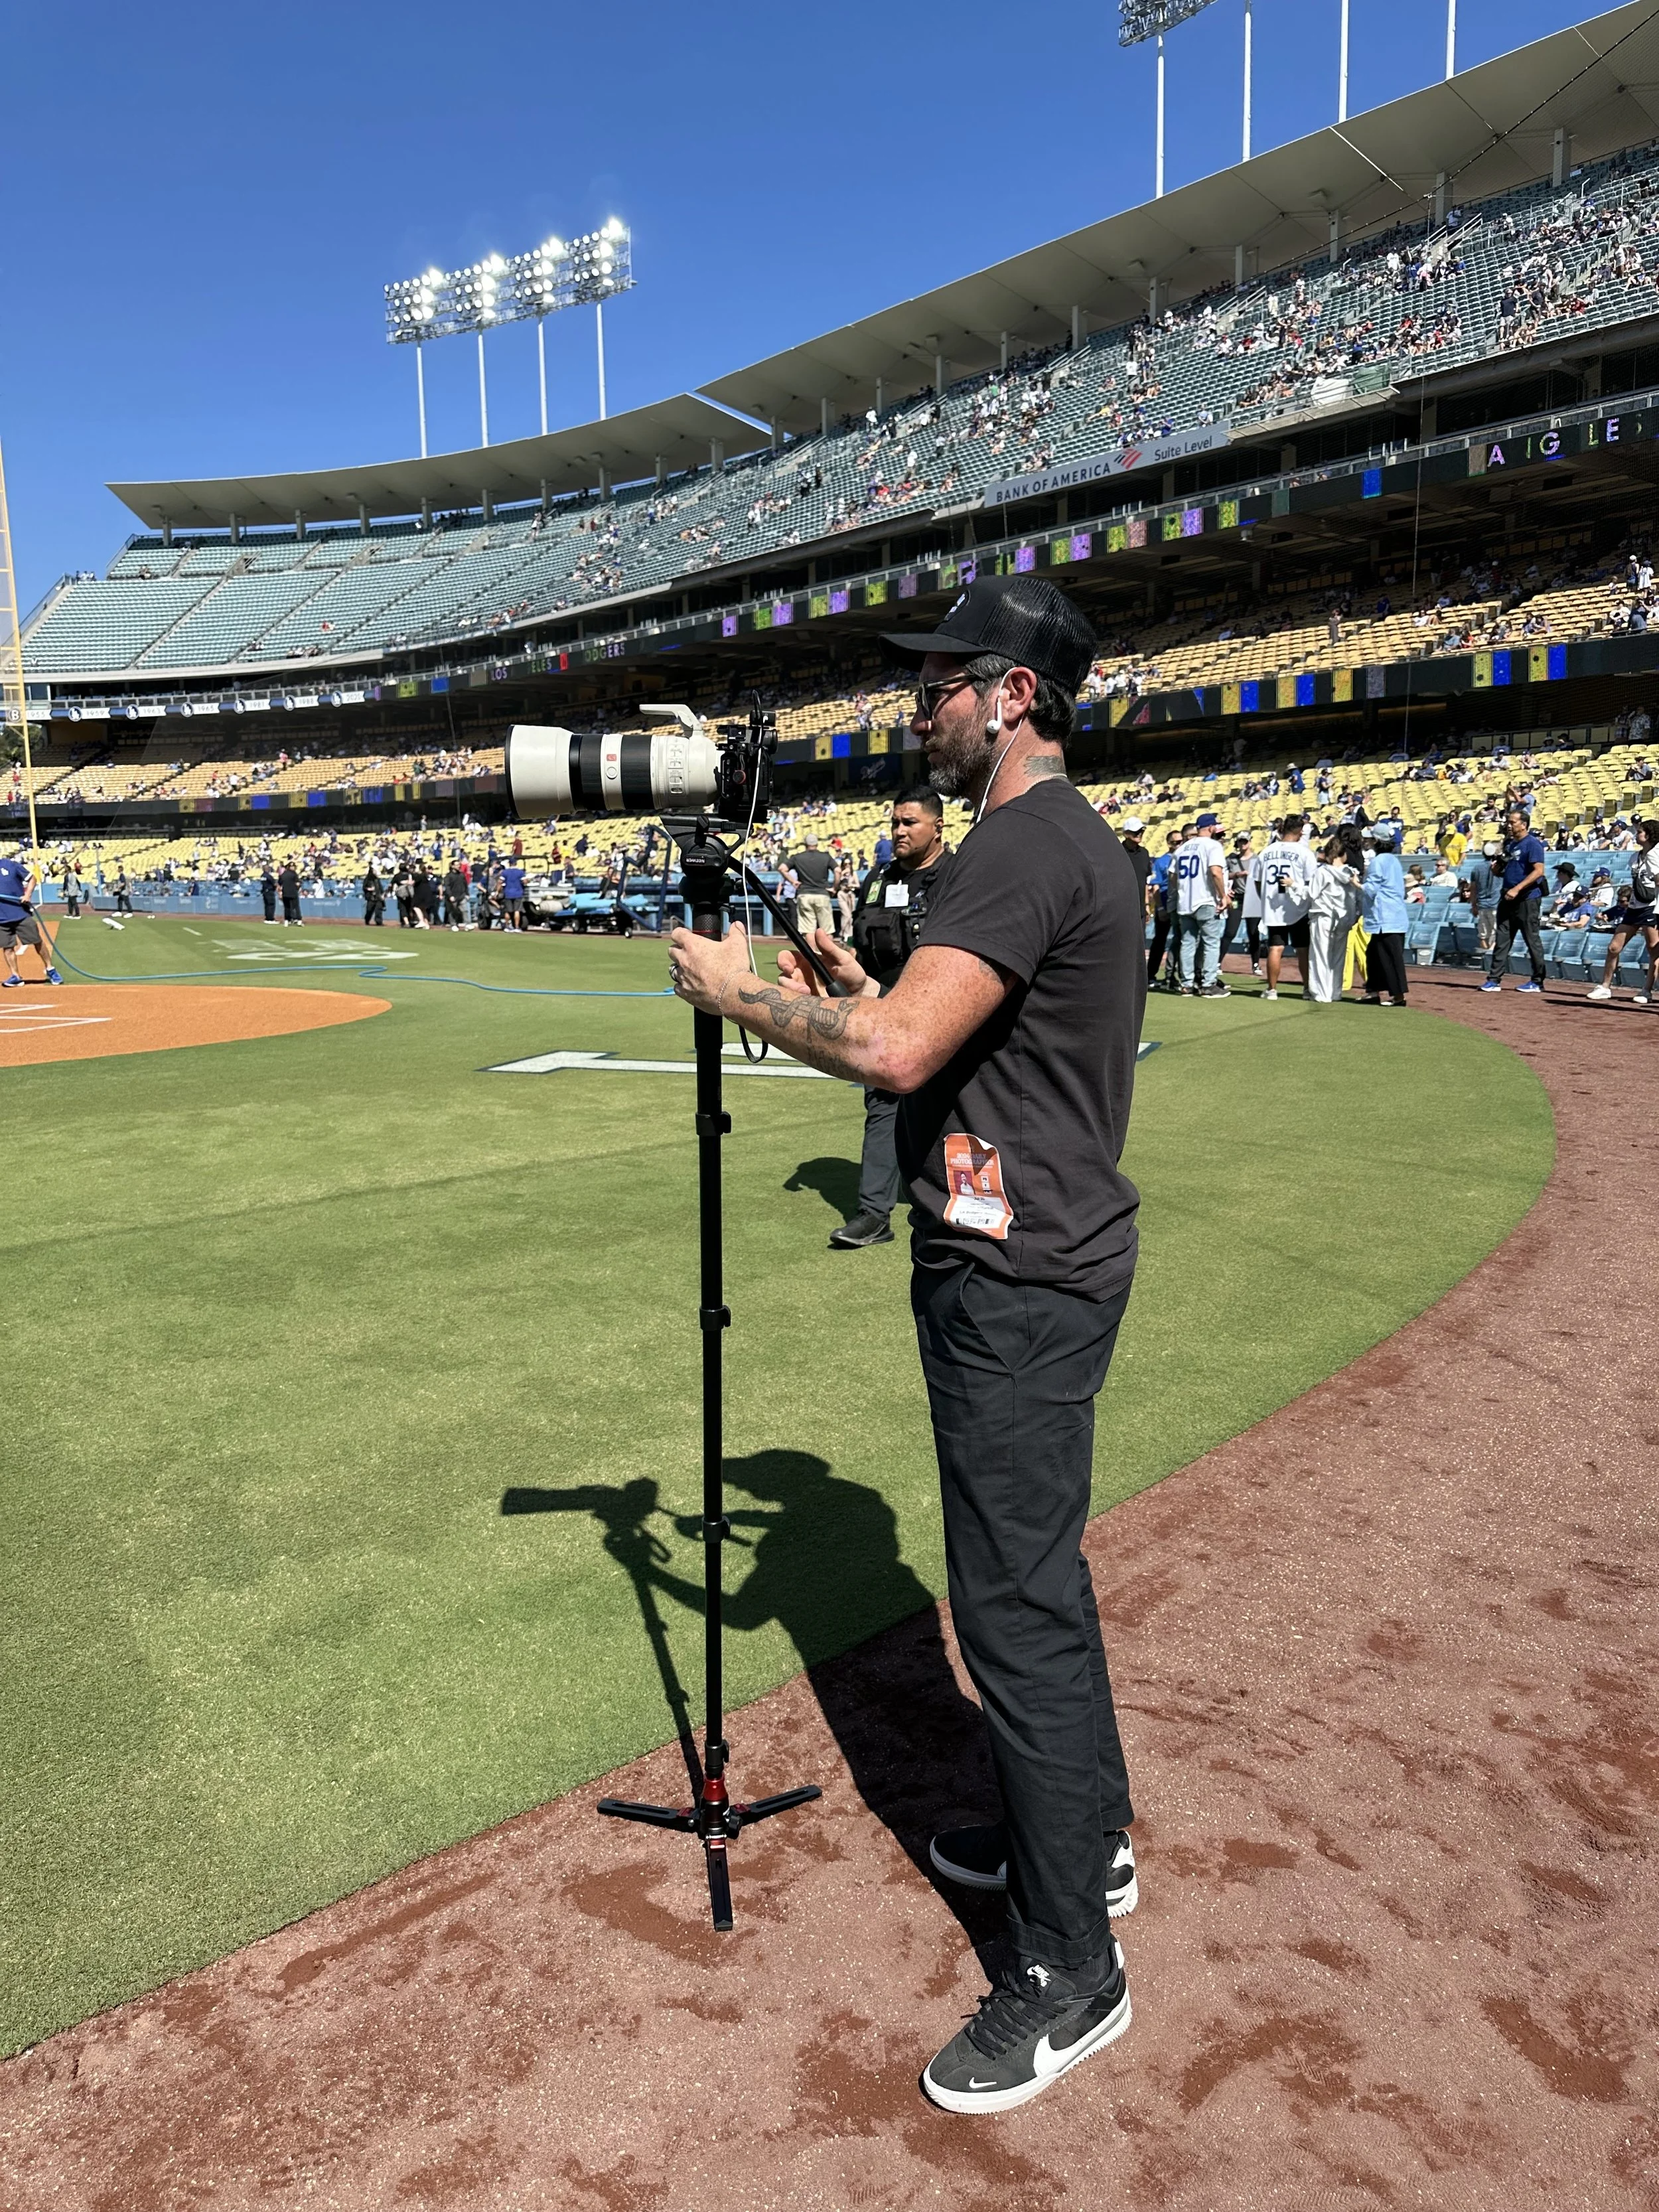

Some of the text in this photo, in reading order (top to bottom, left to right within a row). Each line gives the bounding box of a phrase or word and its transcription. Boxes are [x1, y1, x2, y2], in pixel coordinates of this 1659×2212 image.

[1154, 436, 1212, 461] Suite Level
[996, 463, 1111, 502] BANK OF AMERICA
[490, 667, 508, 681] LOS
[1178, 854, 1200, 879] 50
[1263, 850, 1299, 863] BELLINGER
[1266, 865, 1291, 885] 35
[1033, 1964, 1050, 1977] NIKE
